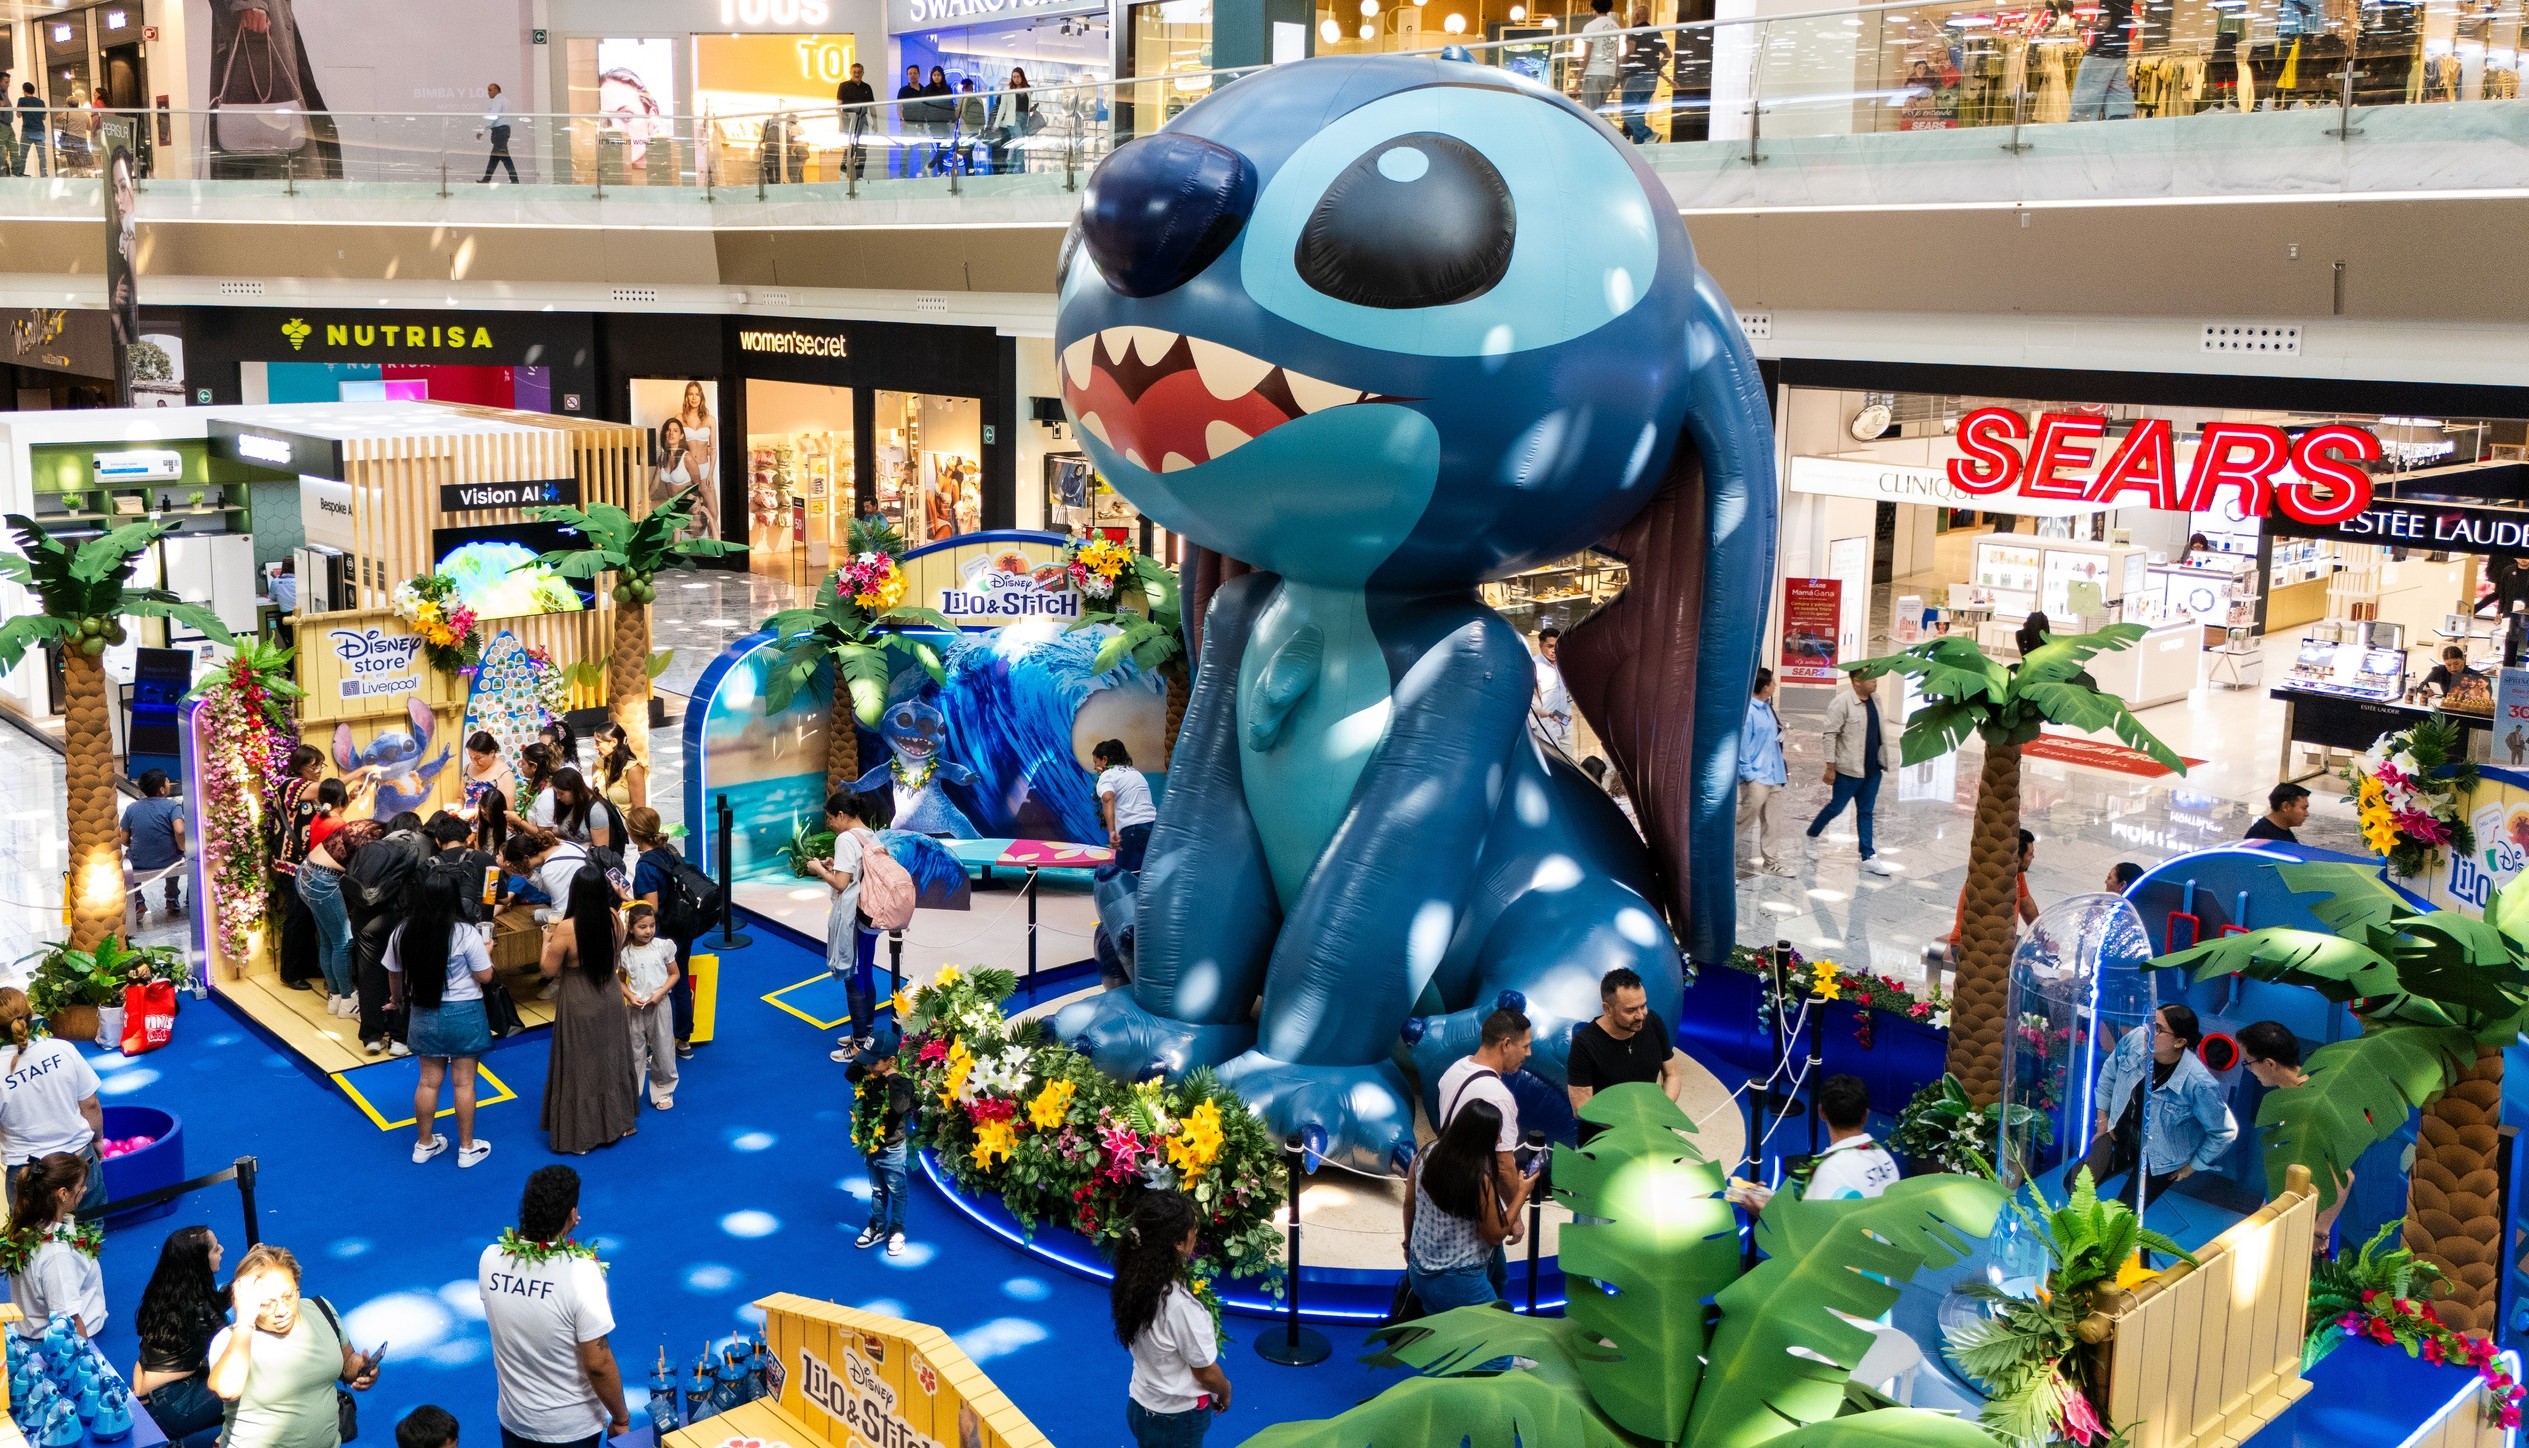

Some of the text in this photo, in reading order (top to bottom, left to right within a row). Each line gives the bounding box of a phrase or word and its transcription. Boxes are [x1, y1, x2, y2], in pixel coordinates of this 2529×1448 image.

[1911, 121, 1946, 130] SEARS
[326, 324, 494, 349] NUTRISA
[740, 330, 847, 357] women'secret
[1946, 406, 2383, 526] SEARS
[460, 485, 540, 506] Vision AI
[320, 497, 347, 516] Bespoke
[987, 573, 1033, 592] Disney
[1814, 589, 1835, 597] Gana
[331, 630, 422, 660] Disney
[354, 657, 405, 673] store
[1791, 668, 1826, 677] SEARS
[362, 677, 417, 694] Liverpool
[2377, 705, 2400, 715] LAUDER
[5, 1053, 63, 1090] STAFF
[489, 1272, 555, 1300] STAFF
[846, 1352, 894, 1411] Disney
